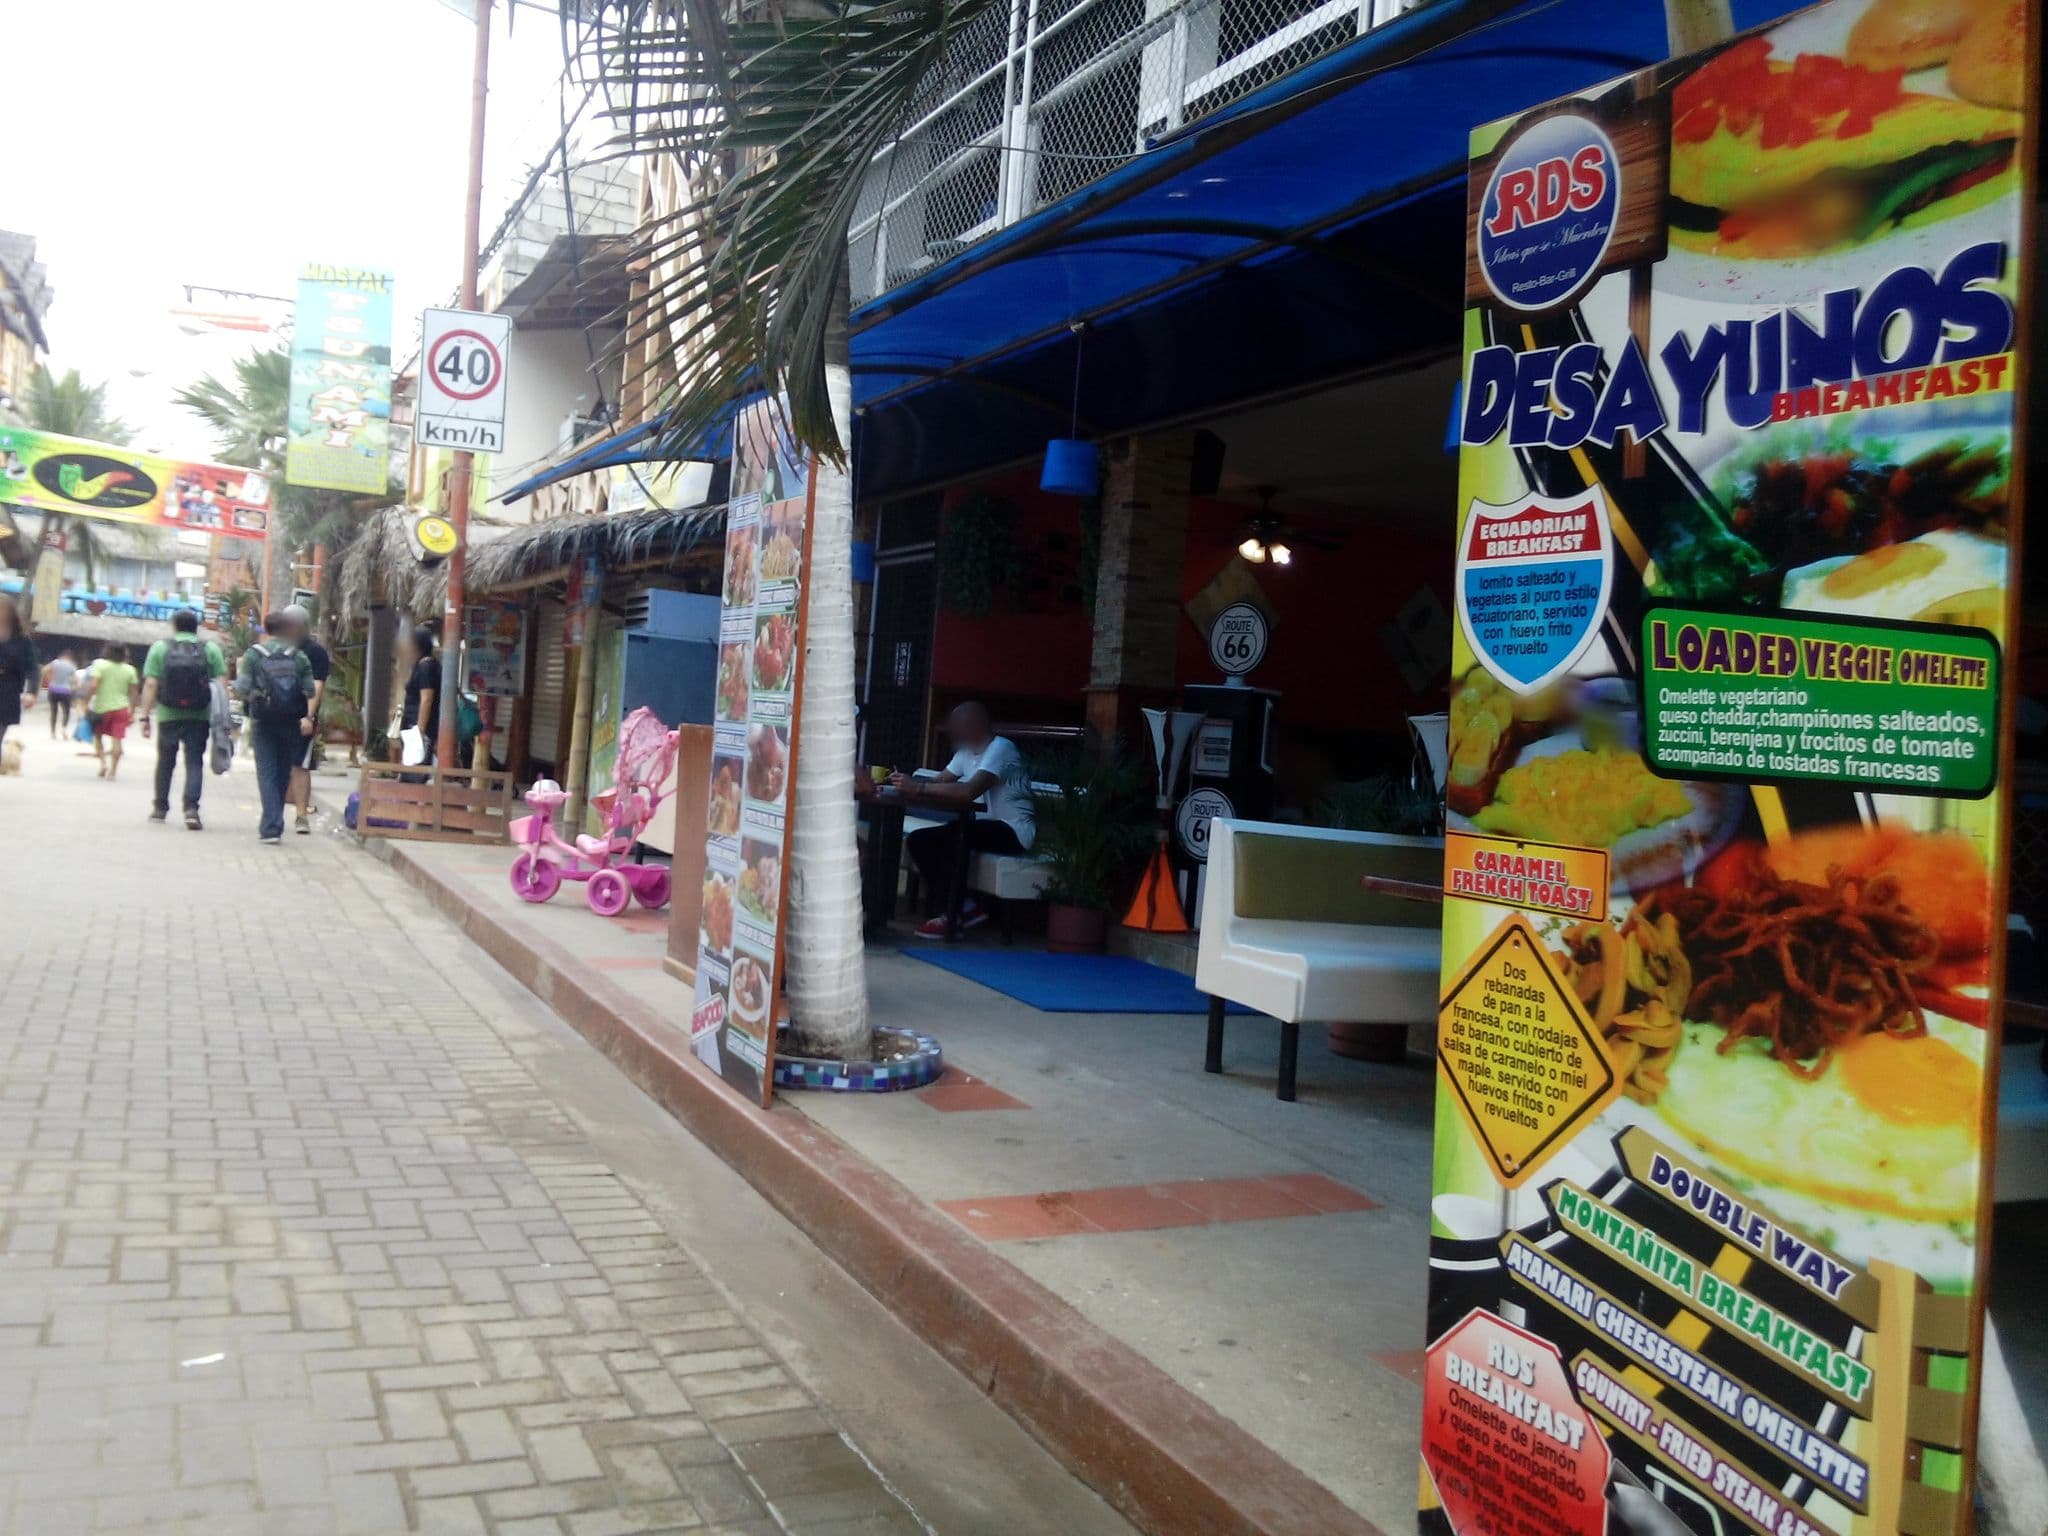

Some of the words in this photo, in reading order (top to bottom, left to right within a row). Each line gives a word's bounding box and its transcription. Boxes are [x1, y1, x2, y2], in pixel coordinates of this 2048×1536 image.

[1485, 144, 1605, 237] RDS
[303, 260, 390, 295] HOSTAL
[1461, 240, 2015, 450] DESAYUNOS
[438, 345, 491, 386] 40
[1770, 357, 2009, 424] BREAKFAST
[424, 420, 496, 447] km/h
[1480, 514, 1587, 540] ECUADORIAN
[1486, 533, 1584, 557] BREAKFAST
[1467, 592, 1517, 611] vegetales
[1521, 590, 1531, 605] al
[1534, 590, 1561, 606] puro
[1564, 584, 1599, 601] estilo
[1479, 573, 1513, 590] lomito
[1516, 571, 1565, 587] salteado
[1568, 571, 1577, 586] y
[1224, 619, 1251, 632] ROUTE
[1471, 607, 1540, 625] ecuatoriano,
[1543, 604, 1588, 620] servido
[1483, 626, 1504, 640] con
[1510, 623, 1545, 639] huevo
[1548, 622, 1573, 637] frito
[1223, 634, 1250, 659] 66
[1492, 645, 1499, 656] o
[1502, 640, 1548, 656] revuelto
[1651, 620, 1801, 679] LOADED
[1801, 637, 1894, 685] VEGGIE
[1898, 649, 1989, 690] OMELETTE
[1659, 687, 1716, 706] Omelette
[1719, 685, 1808, 711] vegetariano
[1659, 710, 1698, 728] queso
[1878, 709, 1986, 738] salteados,
[1658, 727, 1707, 748] zuccini,
[1710, 729, 1783, 753] berenjena
[1786, 735, 1796, 752] y
[1800, 730, 1868, 753] trocitos
[1872, 733, 1897, 755] de
[1901, 736, 1975, 760] tomate
[1657, 747, 1744, 770] acompañado
[1746, 750, 1766, 770] de
[1769, 753, 1840, 776] tostadas
[1844, 756, 1941, 783] francesas
[1193, 804, 1221, 818] ROUTE
[1473, 849, 1568, 884] CARAMEL
[1452, 868, 1524, 901] FRENCH
[1526, 881, 1592, 913] TOAST
[1503, 961, 1527, 982] Dos
[1482, 994, 1497, 1011] de
[1499, 999, 1522, 1018] pan
[1525, 1005, 1533, 1018] a
[1535, 1004, 1546, 1022] la
[1484, 977, 1545, 1005] rebanadas
[1452, 1019, 1467, 1036] de
[1468, 1021, 1510, 1048] banano
[1512, 1037, 1564, 1065] cubierto
[1567, 1051, 1582, 1069] de
[1506, 1019, 1530, 1037] con
[1532, 1022, 1578, 1050] rodajas
[1443, 1036, 1472, 1057] salsa
[1475, 1045, 1489, 1061] de
[1491, 1049, 1546, 1078] caramelo
[1549, 1066, 1558, 1081] o
[1560, 1068, 1588, 1090] miel
[1468, 1075, 1509, 1102] huevos
[1512, 1088, 1544, 1114] fritos
[1547, 1102, 1556, 1117] o
[1498, 1068, 1543, 1095] servido
[1545, 1085, 1568, 1103] con
[1484, 1101, 1540, 1131] revueltos
[1648, 1152, 1768, 1249] DOUBLE
[1770, 1222, 1857, 1301] WAY
[1556, 1184, 1696, 1297] MONTAÑITA
[1697, 1269, 1874, 1402] BREAKFAST
[1487, 1335, 1536, 1388] RDS
[1505, 1239, 1596, 1320] ATAMARI
[1593, 1294, 1743, 1422] CHEESESTEAK
[1741, 1396, 1869, 1502] OMELETTE
[1445, 1351, 1586, 1452] BREAKFAST
[1448, 1388, 1508, 1436] Omelette
[1511, 1424, 1528, 1448] de
[1532, 1434, 1577, 1475] jamón
[1456, 1435, 1473, 1457] de
[1575, 1358, 1653, 1435] COUNTRY
[1658, 1420, 1714, 1481] FRIED
[1711, 1460, 1779, 1536] STEAK
[1438, 1406, 1447, 1425] y
[1450, 1413, 1491, 1448] queso
[1494, 1439, 1586, 1501] acompañado
